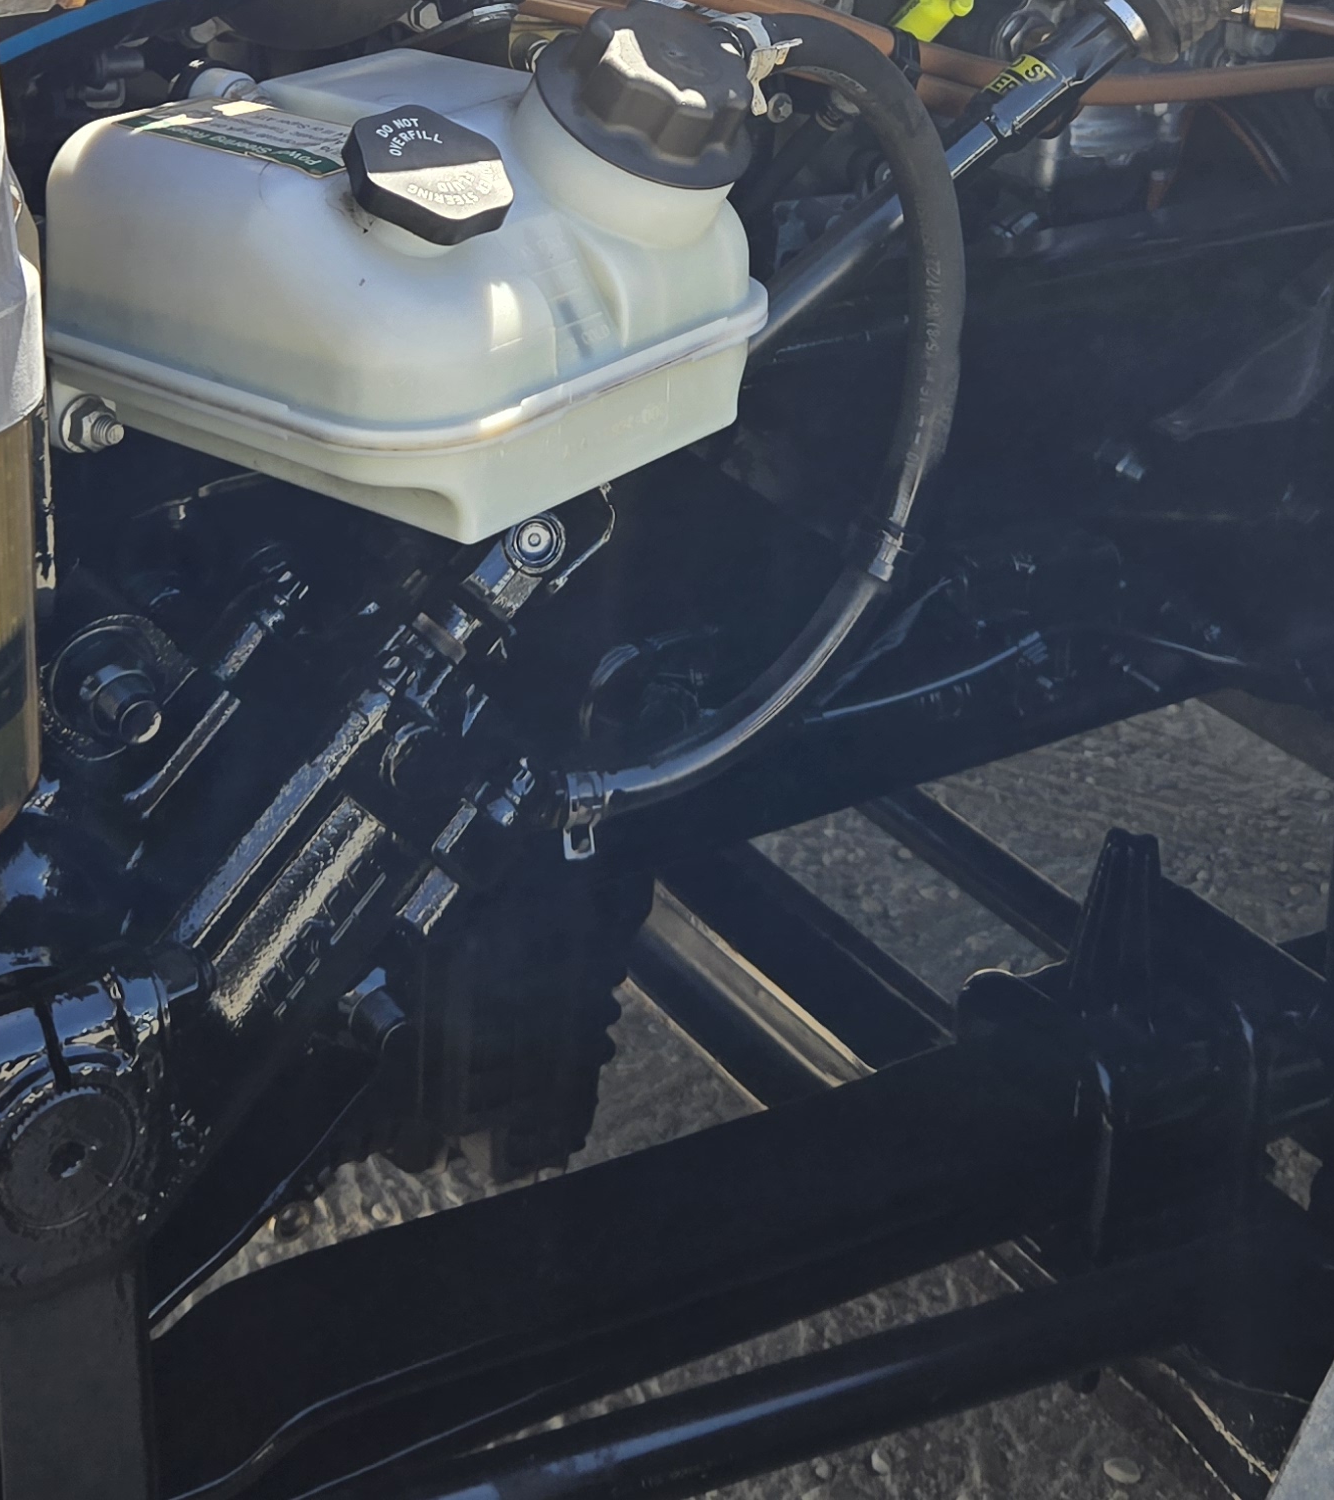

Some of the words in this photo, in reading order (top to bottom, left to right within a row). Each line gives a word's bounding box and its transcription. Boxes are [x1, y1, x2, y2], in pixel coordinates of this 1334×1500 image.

[375, 124, 394, 138] DO
[394, 117, 419, 129] NOT
[389, 130, 443, 157] OVERFILL
[436, 172, 476, 193] FLUID
[406, 183, 480, 206] STEERING
